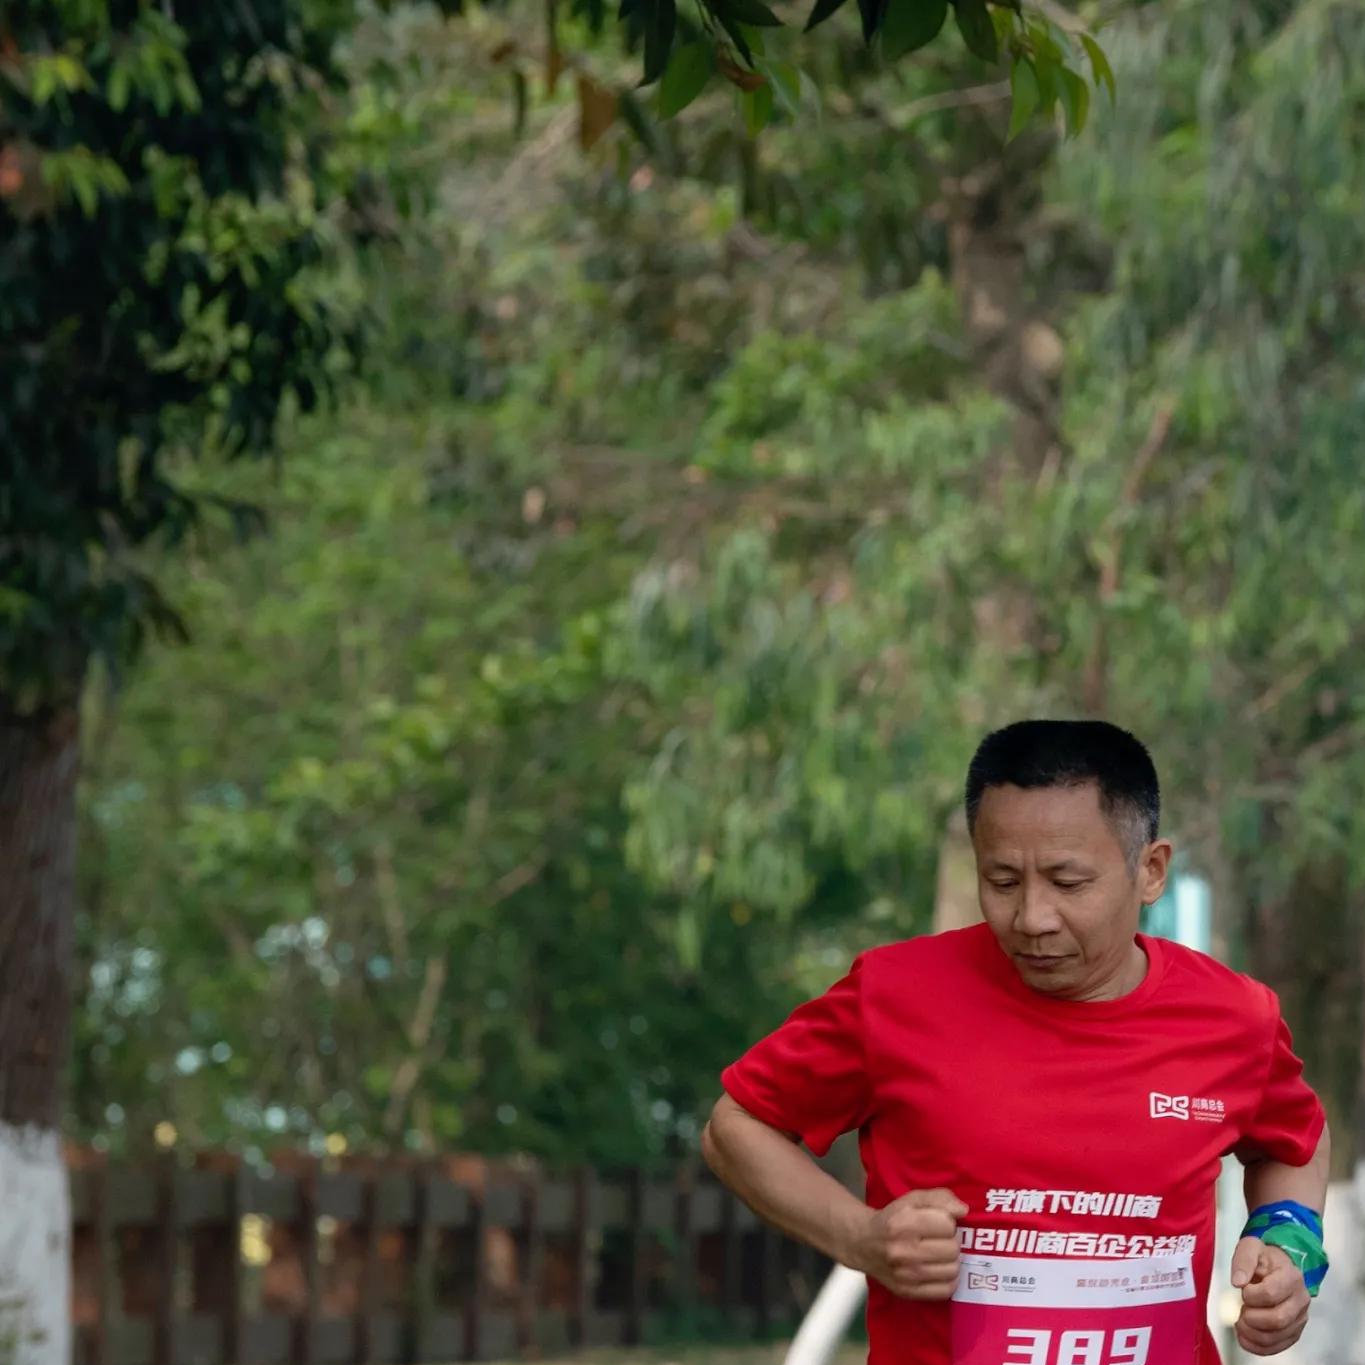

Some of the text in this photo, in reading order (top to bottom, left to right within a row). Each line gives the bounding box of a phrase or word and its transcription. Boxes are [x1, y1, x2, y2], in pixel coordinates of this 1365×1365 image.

[985, 1189, 1163, 1219] 党旗下的川商
